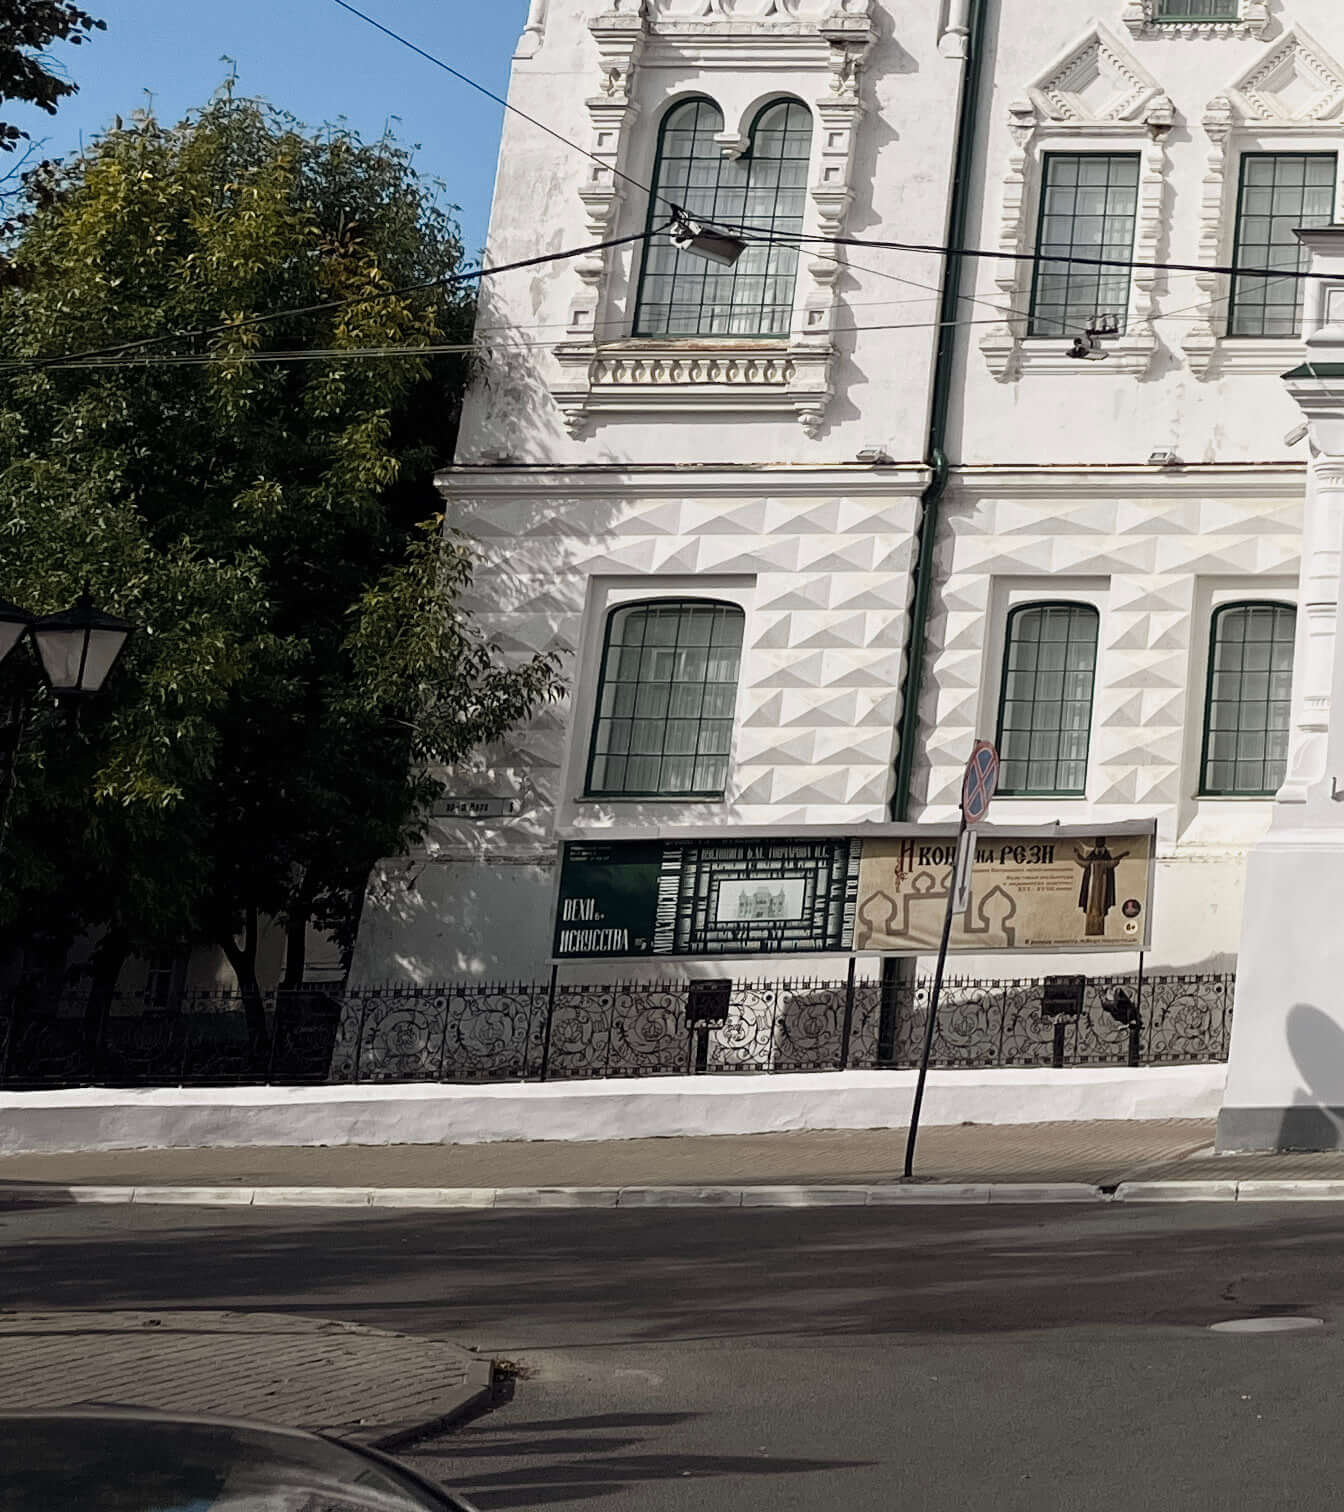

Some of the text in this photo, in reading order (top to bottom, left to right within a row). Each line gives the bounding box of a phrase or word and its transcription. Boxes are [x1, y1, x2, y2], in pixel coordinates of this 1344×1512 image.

[563, 898, 595, 921] ВЕХИ
[651, 875, 681, 955] АЙВАЗОВСКИЙ
[560, 928, 629, 953] ИСКУССТВА
